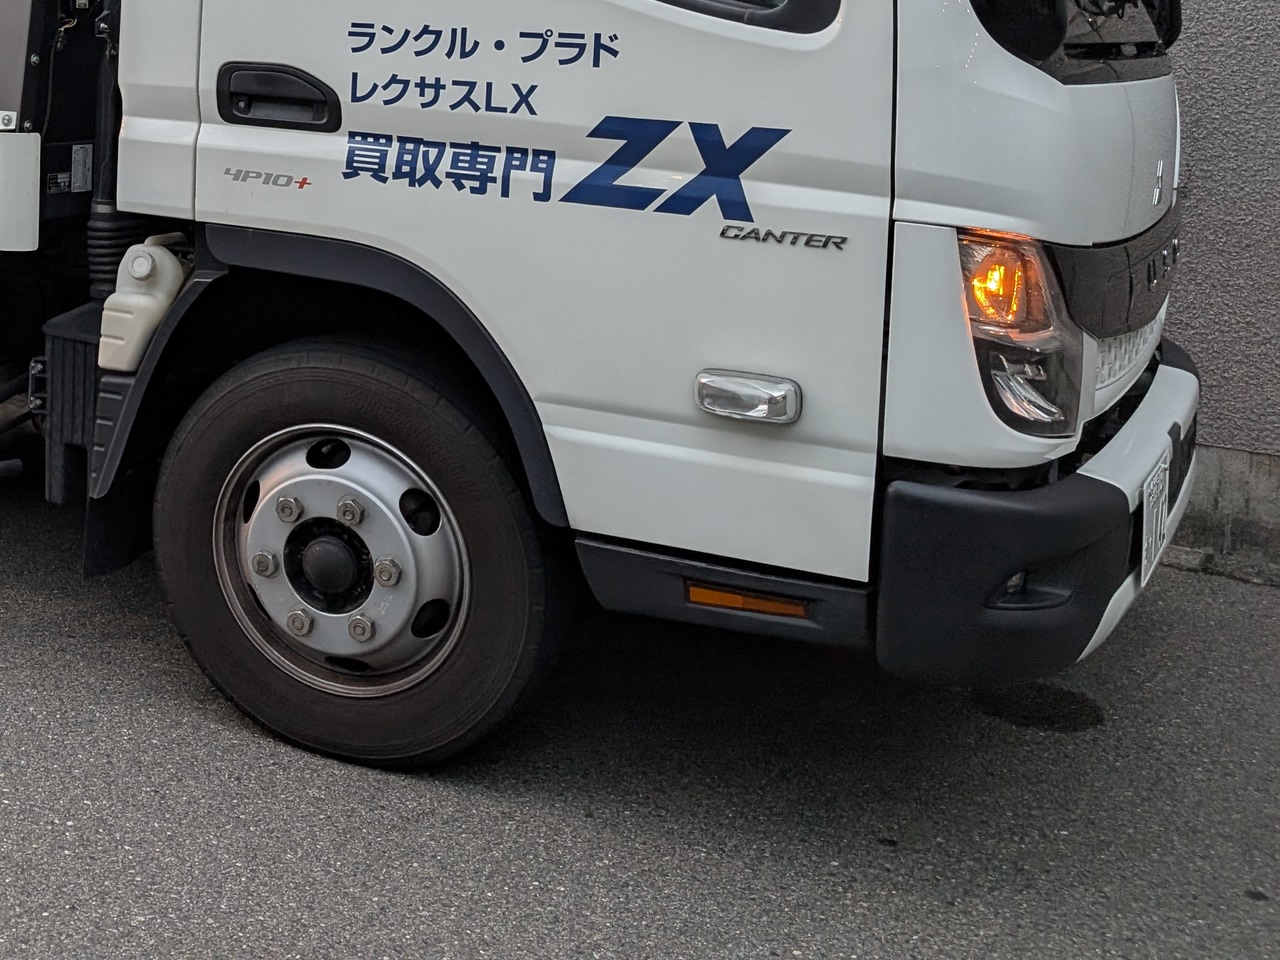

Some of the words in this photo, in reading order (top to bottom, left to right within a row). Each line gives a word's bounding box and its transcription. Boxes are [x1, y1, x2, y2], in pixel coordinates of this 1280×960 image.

[346, 21, 621, 69] ランクル・プラド
[349, 71, 539, 116] レクサスLX
[223, 167, 313, 190] 4P10+
[340, 130, 557, 203] 買取専門
[558, 114, 794, 224] ZX
[720, 224, 849, 251] CANTER
